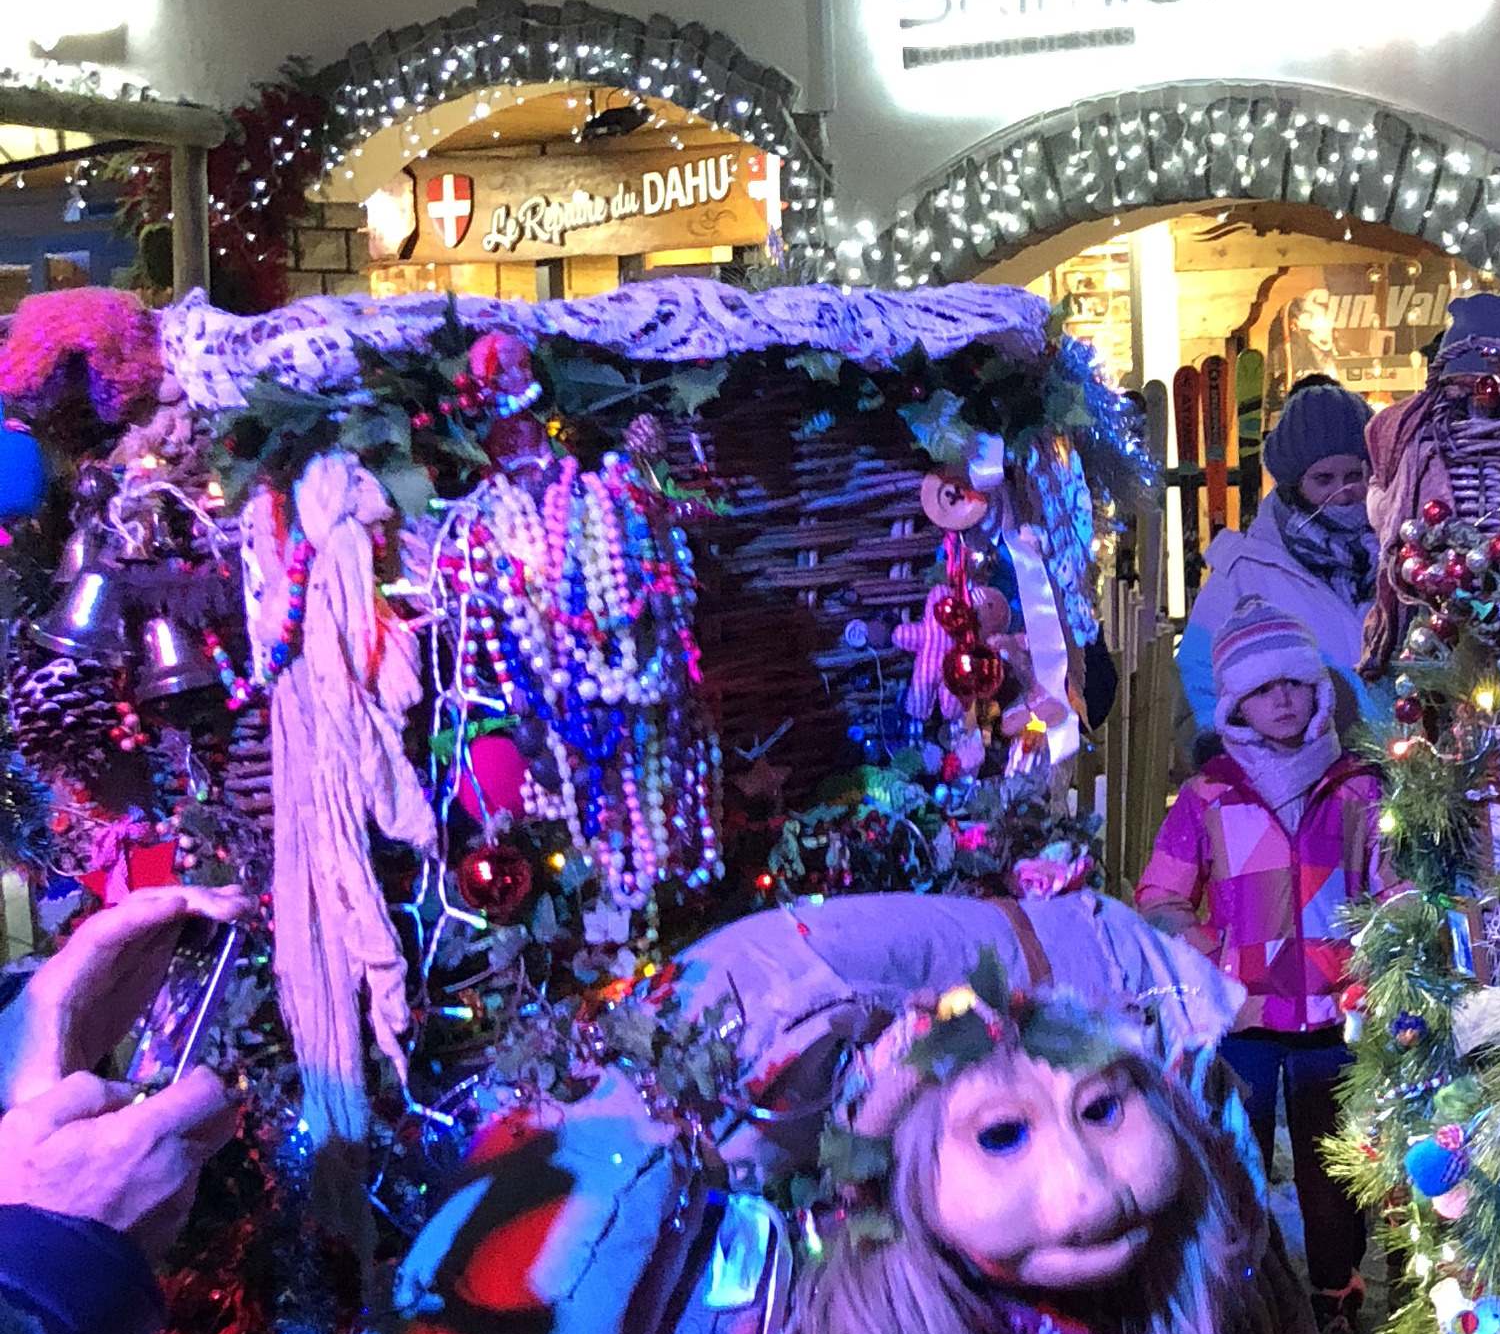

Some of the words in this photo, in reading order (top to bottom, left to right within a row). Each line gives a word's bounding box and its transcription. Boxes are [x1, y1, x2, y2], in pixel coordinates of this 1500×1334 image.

[481, 206, 519, 252] Le
[610, 182, 640, 219] du
[642, 154, 732, 216] DAHU
[1298, 289, 1378, 330] Sun
